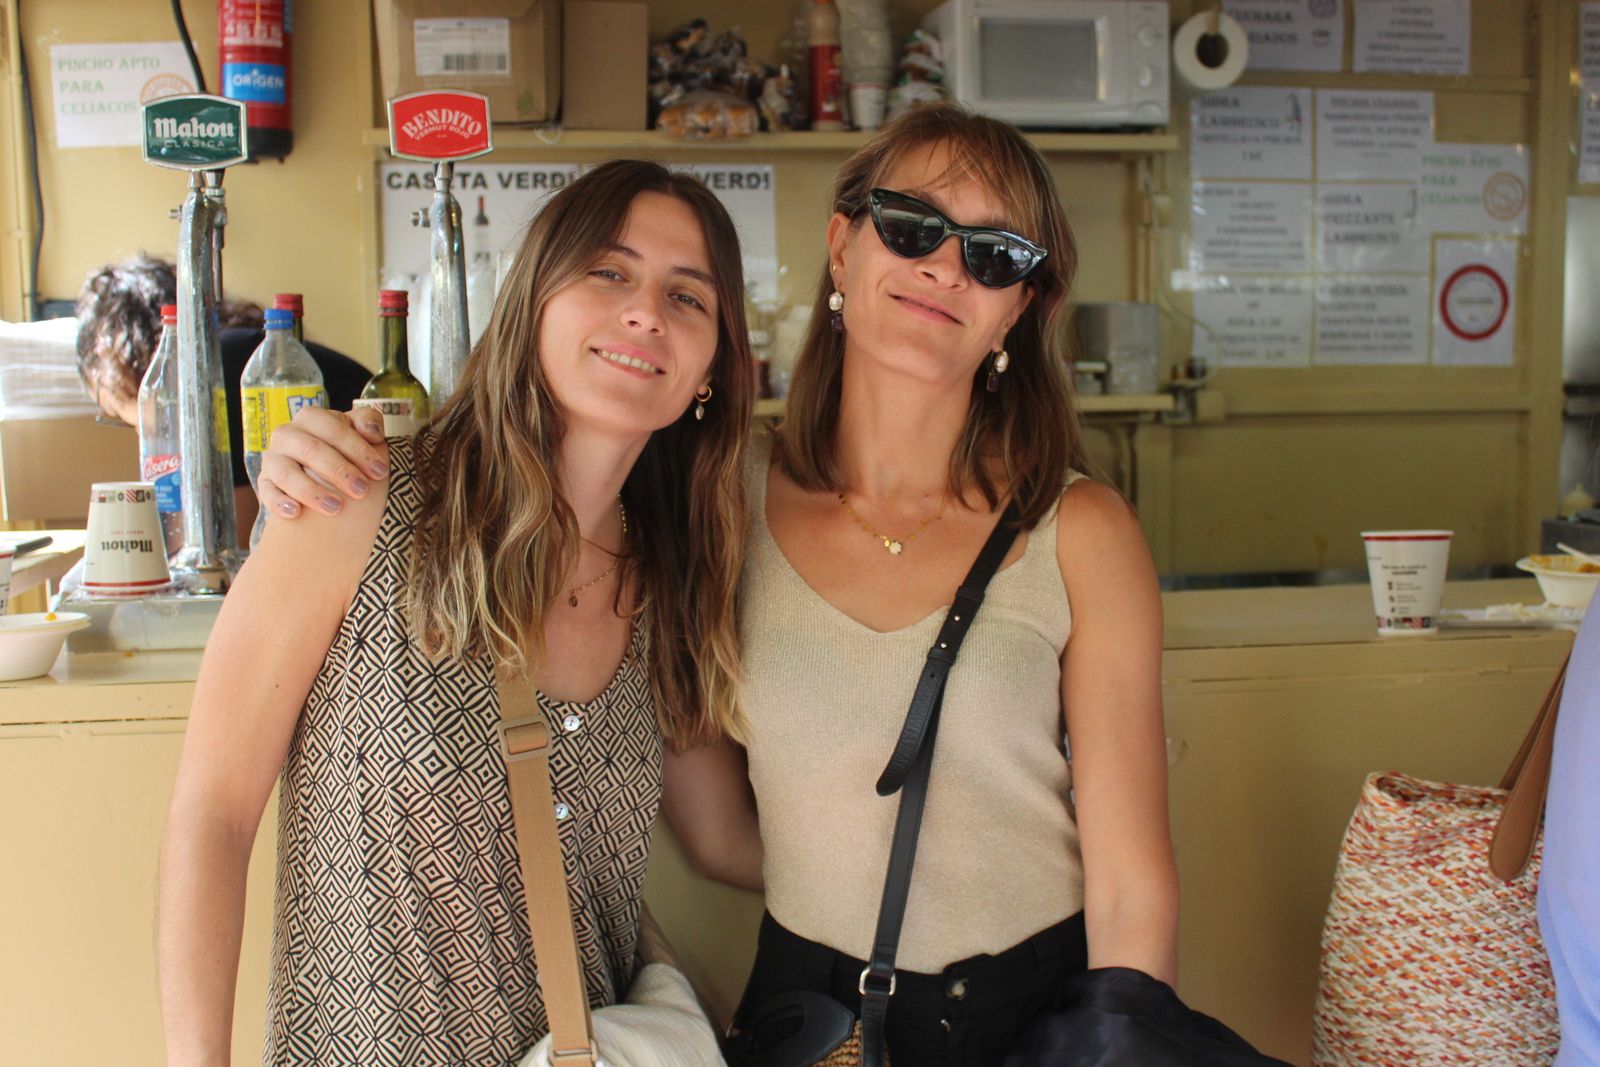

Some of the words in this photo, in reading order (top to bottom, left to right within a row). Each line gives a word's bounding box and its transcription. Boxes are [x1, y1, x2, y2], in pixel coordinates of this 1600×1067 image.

[57, 58, 114, 71] PINCHO
[117, 56, 161, 69] APTO
[59, 80, 105, 93] PARA
[154, 117, 235, 139] Mahou
[401, 108, 482, 139] BENDITO
[414, 125, 447, 141] VERMUT
[449, 125, 471, 139] ROJO
[386, 171, 488, 190] CASTA
[101, 540, 153, 553] Mahou
